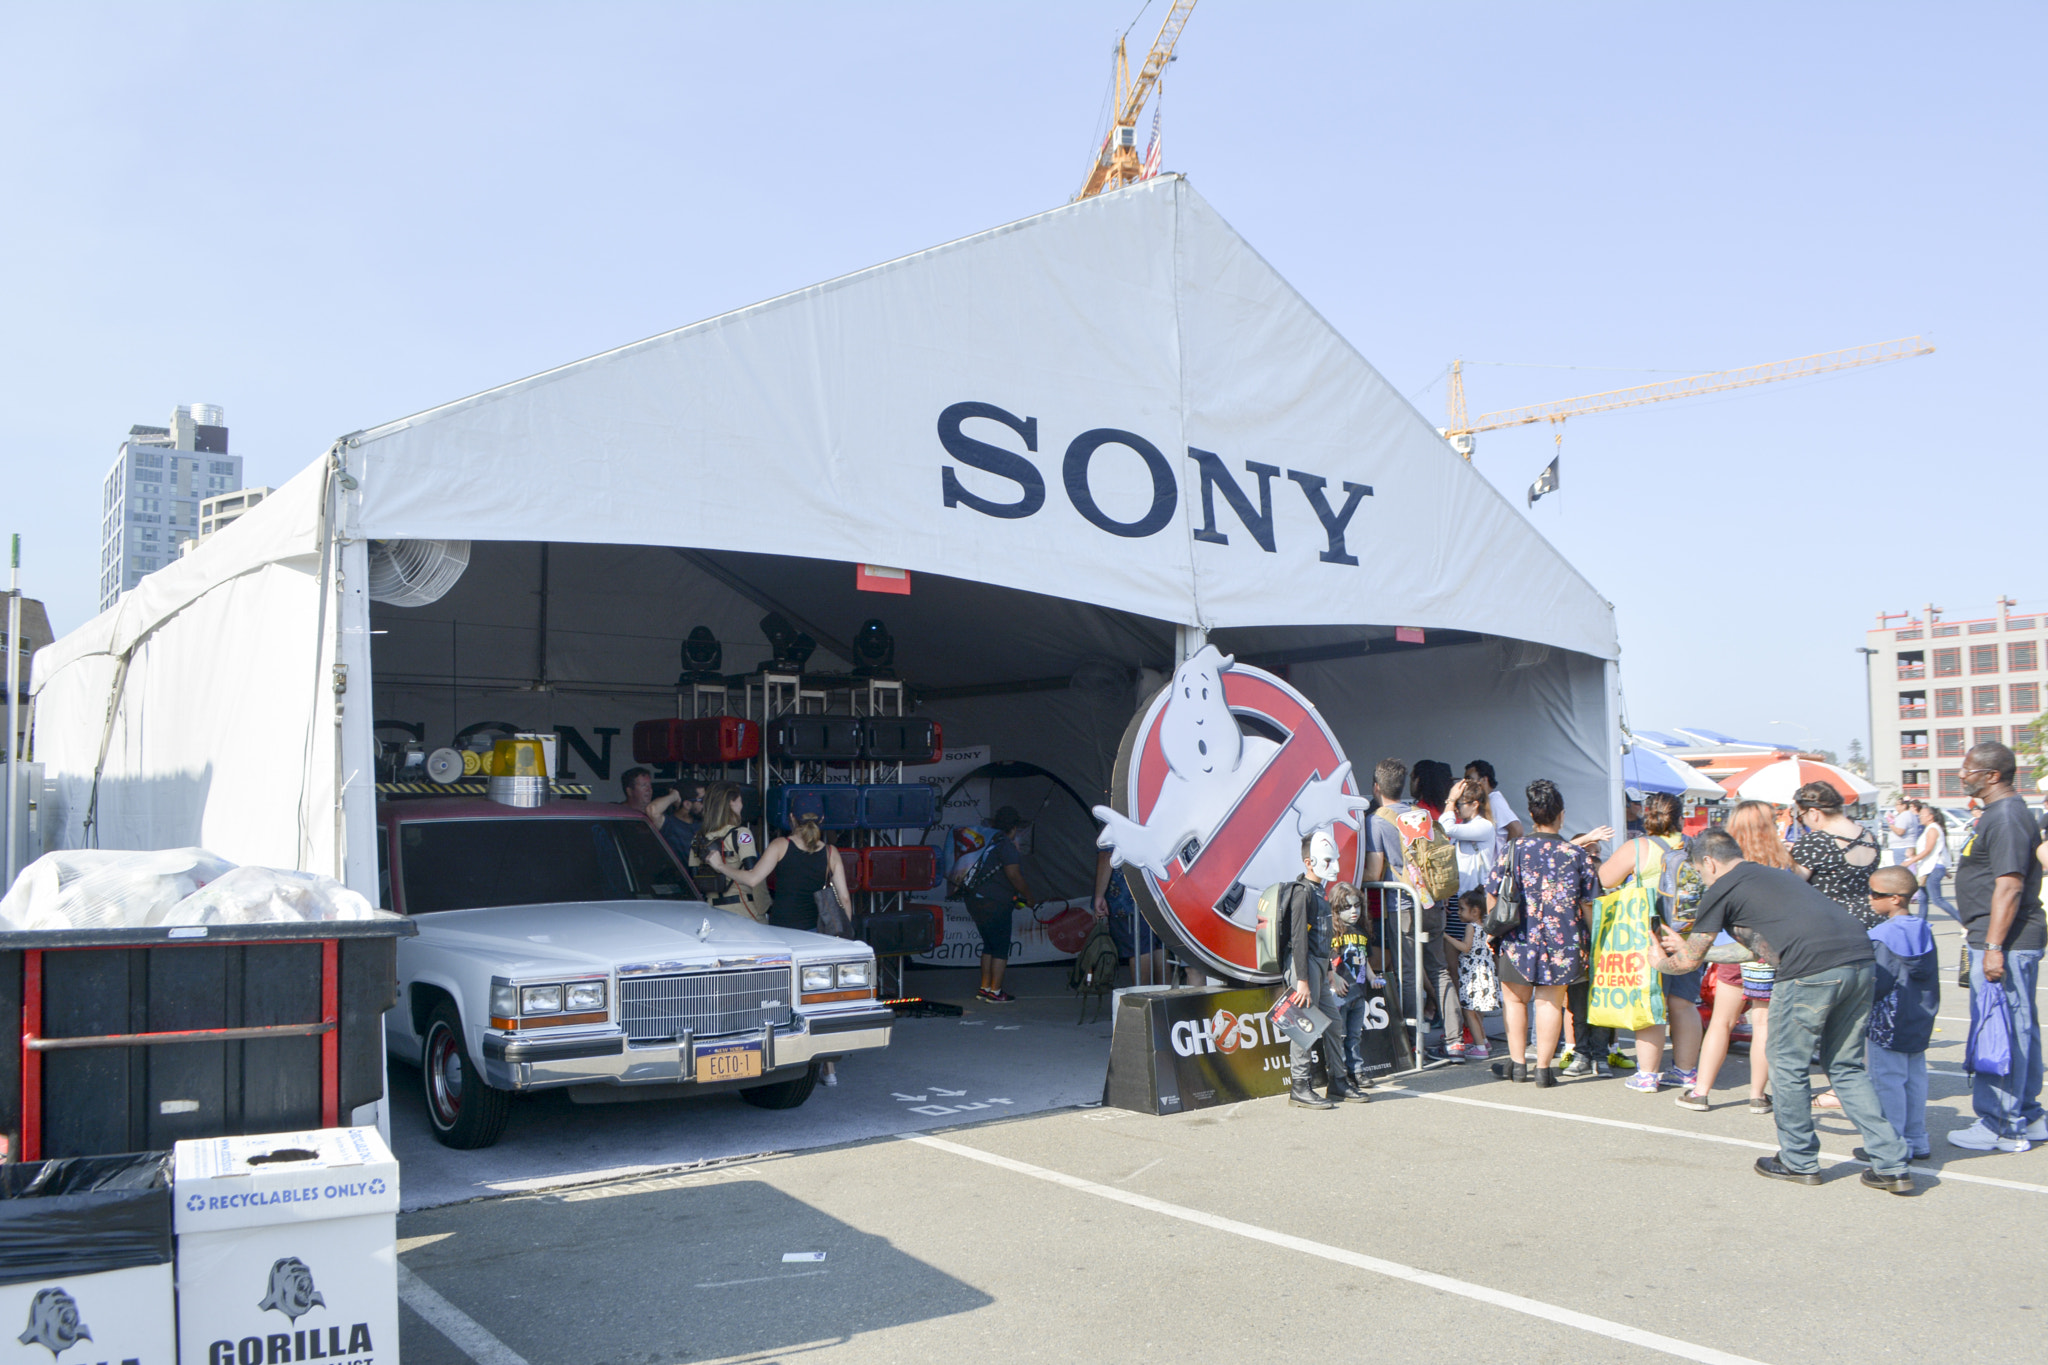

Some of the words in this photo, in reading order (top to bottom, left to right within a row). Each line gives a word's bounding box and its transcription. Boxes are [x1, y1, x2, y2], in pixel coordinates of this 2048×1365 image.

[937, 401, 1374, 566] SONY
[945, 751, 981, 761] SONY
[919, 775, 955, 784] SONY
[944, 799, 980, 808] SONY
[946, 914, 974, 922] Tenni
[711, 1054, 749, 1075] ECTO-1
[1263, 1055, 1291, 1071] JUL
[1282, 1076, 1292, 1086] IN
[209, 1187, 319, 1210] RECYCLABLES
[324, 1182, 367, 1199] ONLY
[208, 1322, 373, 1365] GORILLA
